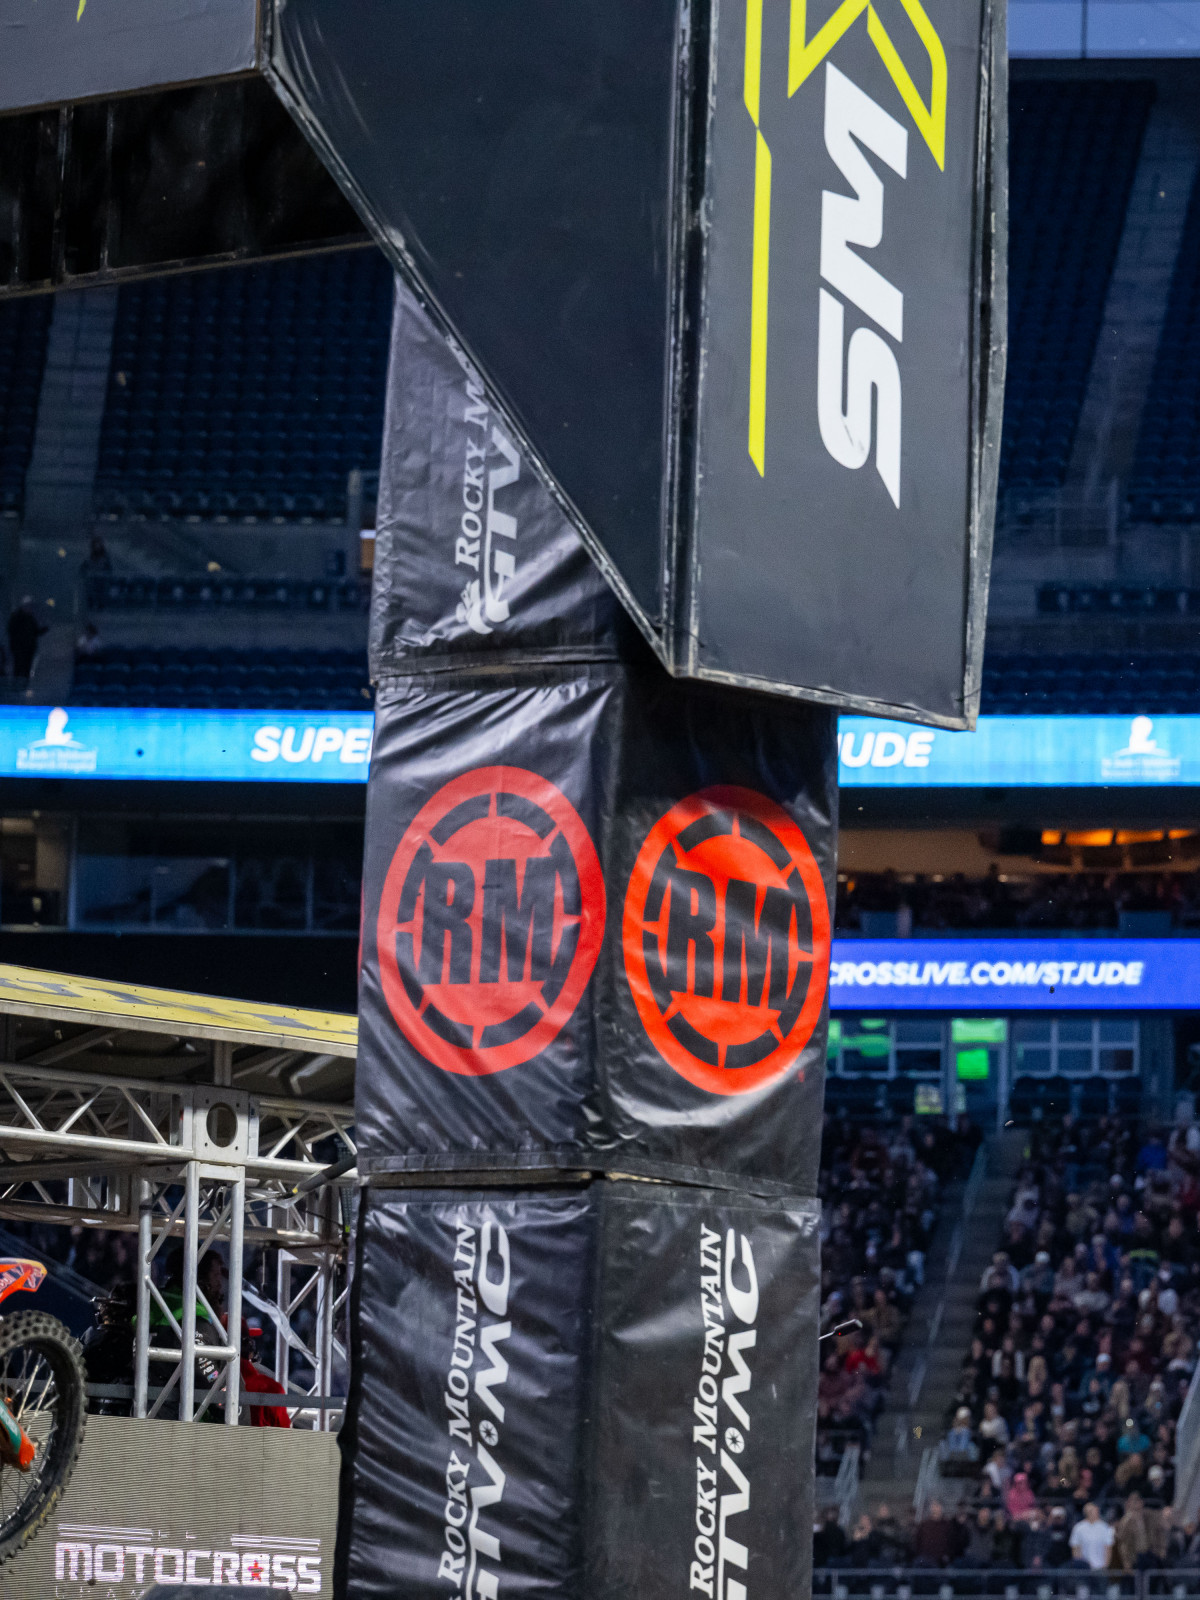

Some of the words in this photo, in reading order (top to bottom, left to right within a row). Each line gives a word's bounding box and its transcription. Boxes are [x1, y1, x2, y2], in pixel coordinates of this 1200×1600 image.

[455, 436, 486, 572] ROCKY
[250, 726, 374, 763] SUPE
[838, 731, 936, 768] UDE
[420, 857, 553, 986] RM
[665, 866, 800, 1011] RM
[444, 1219, 478, 1447] MOUNTAIN
[693, 1222, 726, 1454] MOUNTAIN
[55, 1542, 322, 1593] MOTOCROSS
[437, 1450, 470, 1588] ROCKY
[689, 1456, 718, 1598] ROCKY
